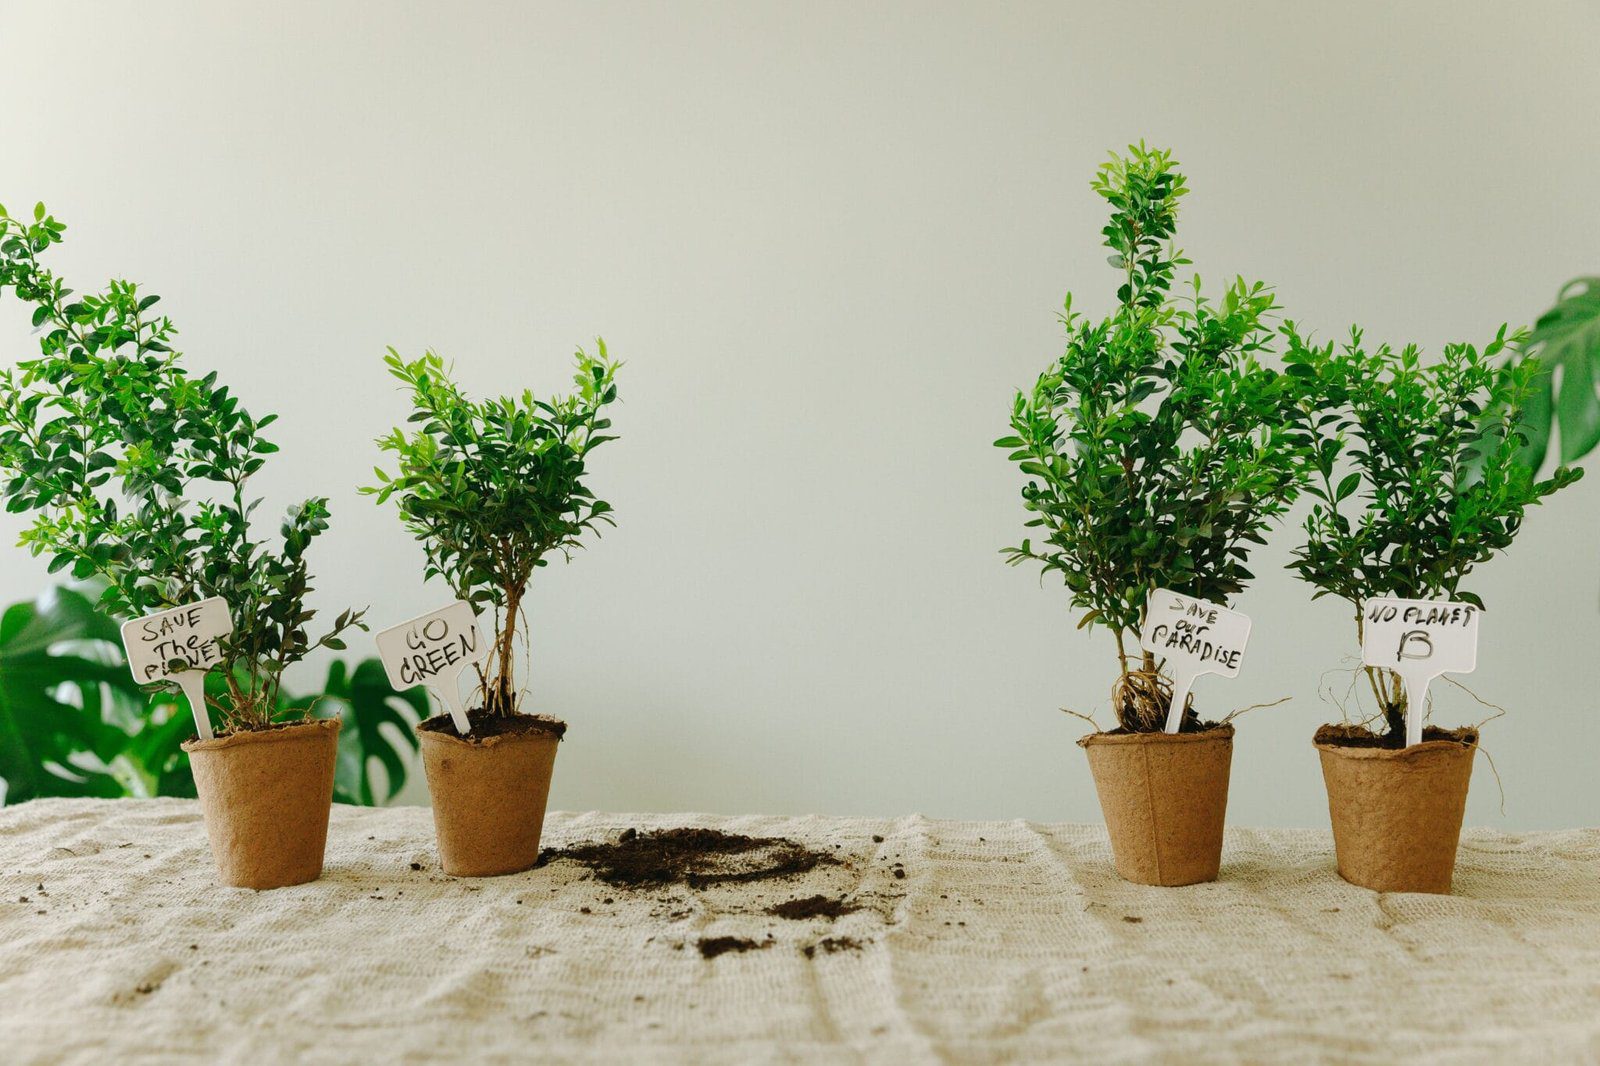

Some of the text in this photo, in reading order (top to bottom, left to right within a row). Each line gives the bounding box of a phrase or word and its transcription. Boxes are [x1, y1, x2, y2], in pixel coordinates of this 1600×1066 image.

[142, 607, 203, 641] SAVE
[1169, 598, 1218, 624] SAVE
[1369, 605, 1476, 627] NO PLANET
[406, 618, 449, 650] GO
[144, 633, 230, 680] PLNET
[400, 625, 476, 684] GREEN
